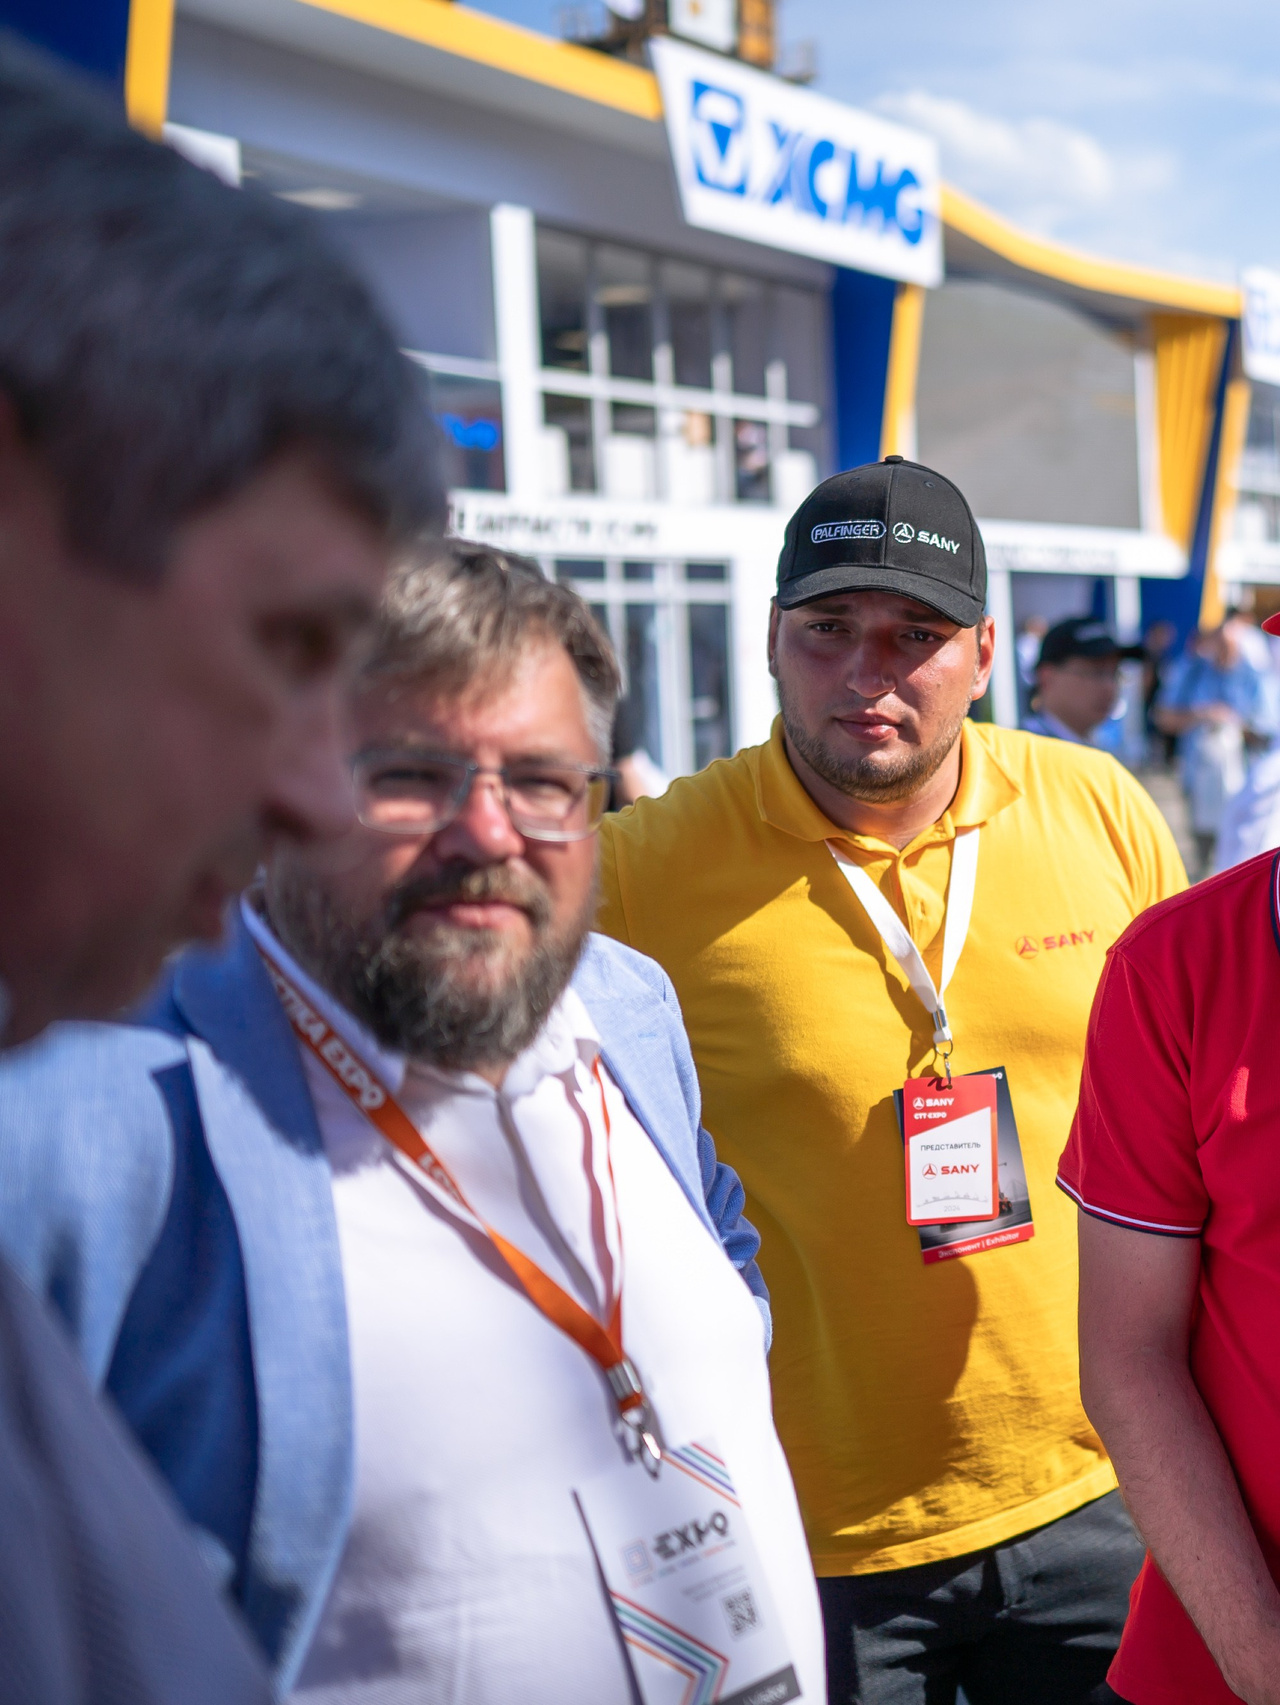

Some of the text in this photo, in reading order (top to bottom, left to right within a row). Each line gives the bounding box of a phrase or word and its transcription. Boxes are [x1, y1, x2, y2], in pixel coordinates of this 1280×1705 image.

[764, 118, 923, 245] XCMG
[814, 523, 880, 540] PALFINGER
[917, 530, 960, 554] SANY
[1042, 930, 1094, 950] SANY
[926, 1098, 954, 1107] SANY
[920, 1142, 981, 1152] ПРЕДСТАВИТЕЛЬ
[941, 1163, 979, 1175] SANY
[986, 1232, 1019, 1246] Exhibitor
